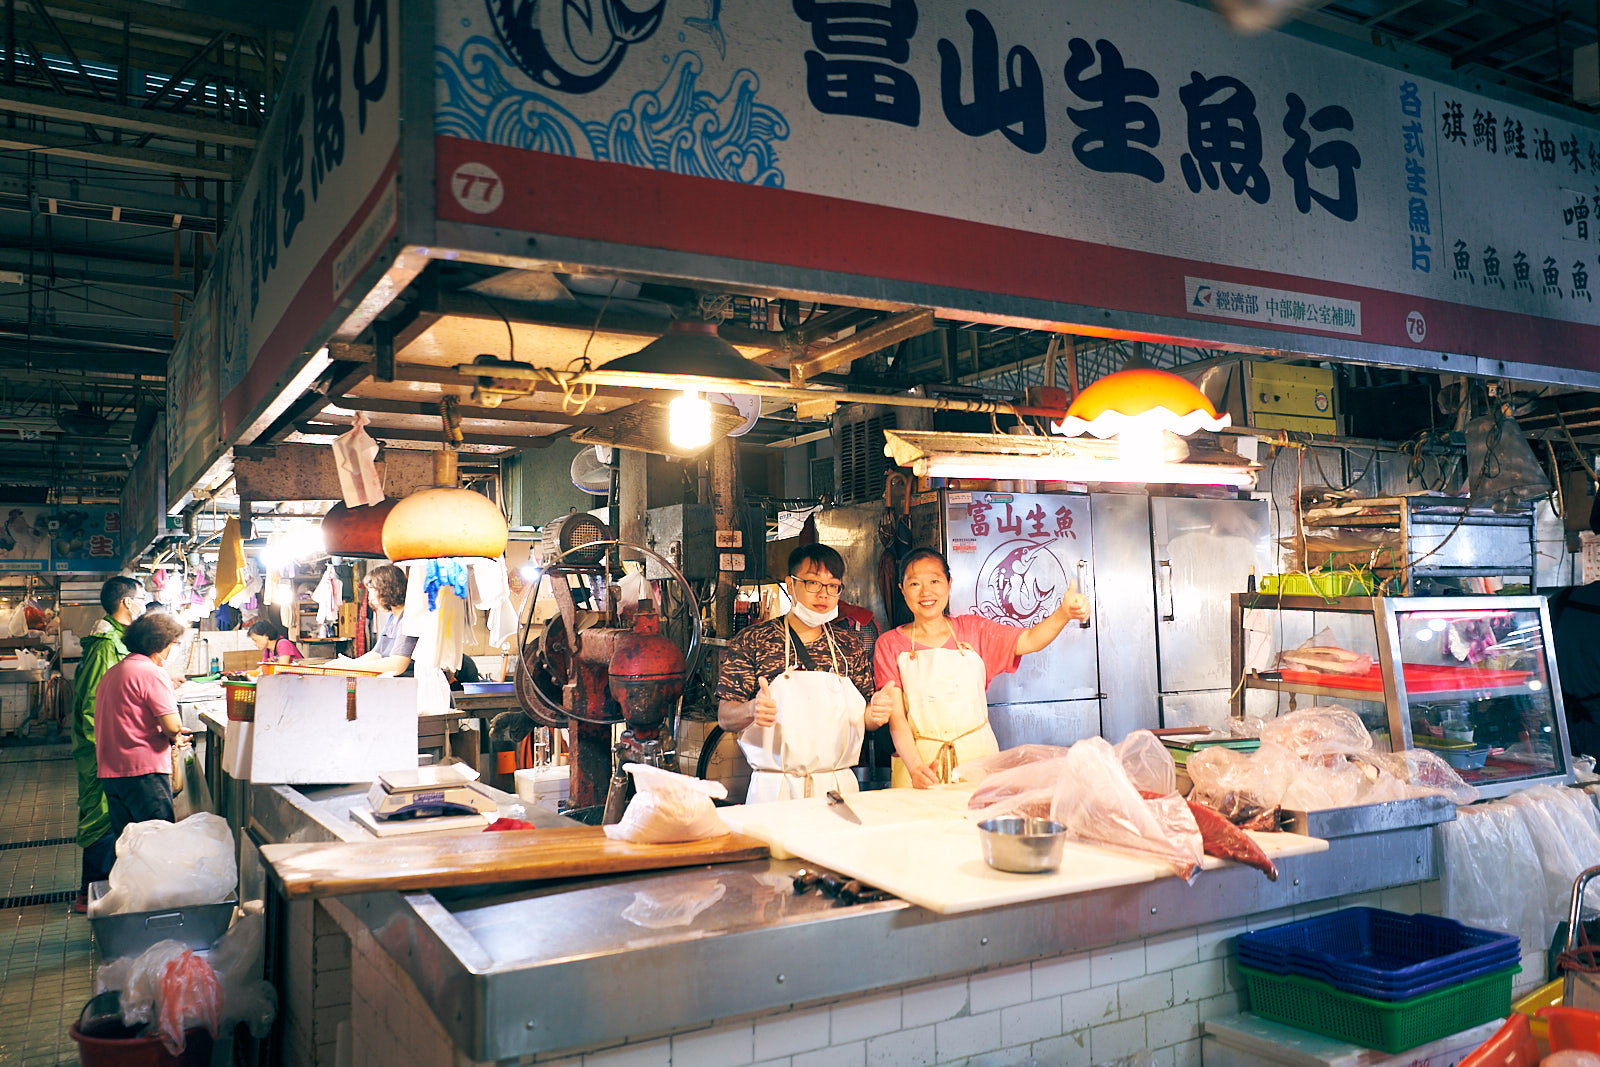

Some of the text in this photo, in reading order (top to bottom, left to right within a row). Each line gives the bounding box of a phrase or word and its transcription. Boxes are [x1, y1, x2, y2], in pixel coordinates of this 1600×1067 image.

[793, 0, 1361, 222] 富山生魚行
[456, 173, 499, 202] 77
[1216, 289, 1356, 328] 經濟部 中部辦公室補助
[1407, 317, 1425, 336] 78
[967, 500, 1077, 540] 富山生魚
[91, 536, 113, 556] 生
